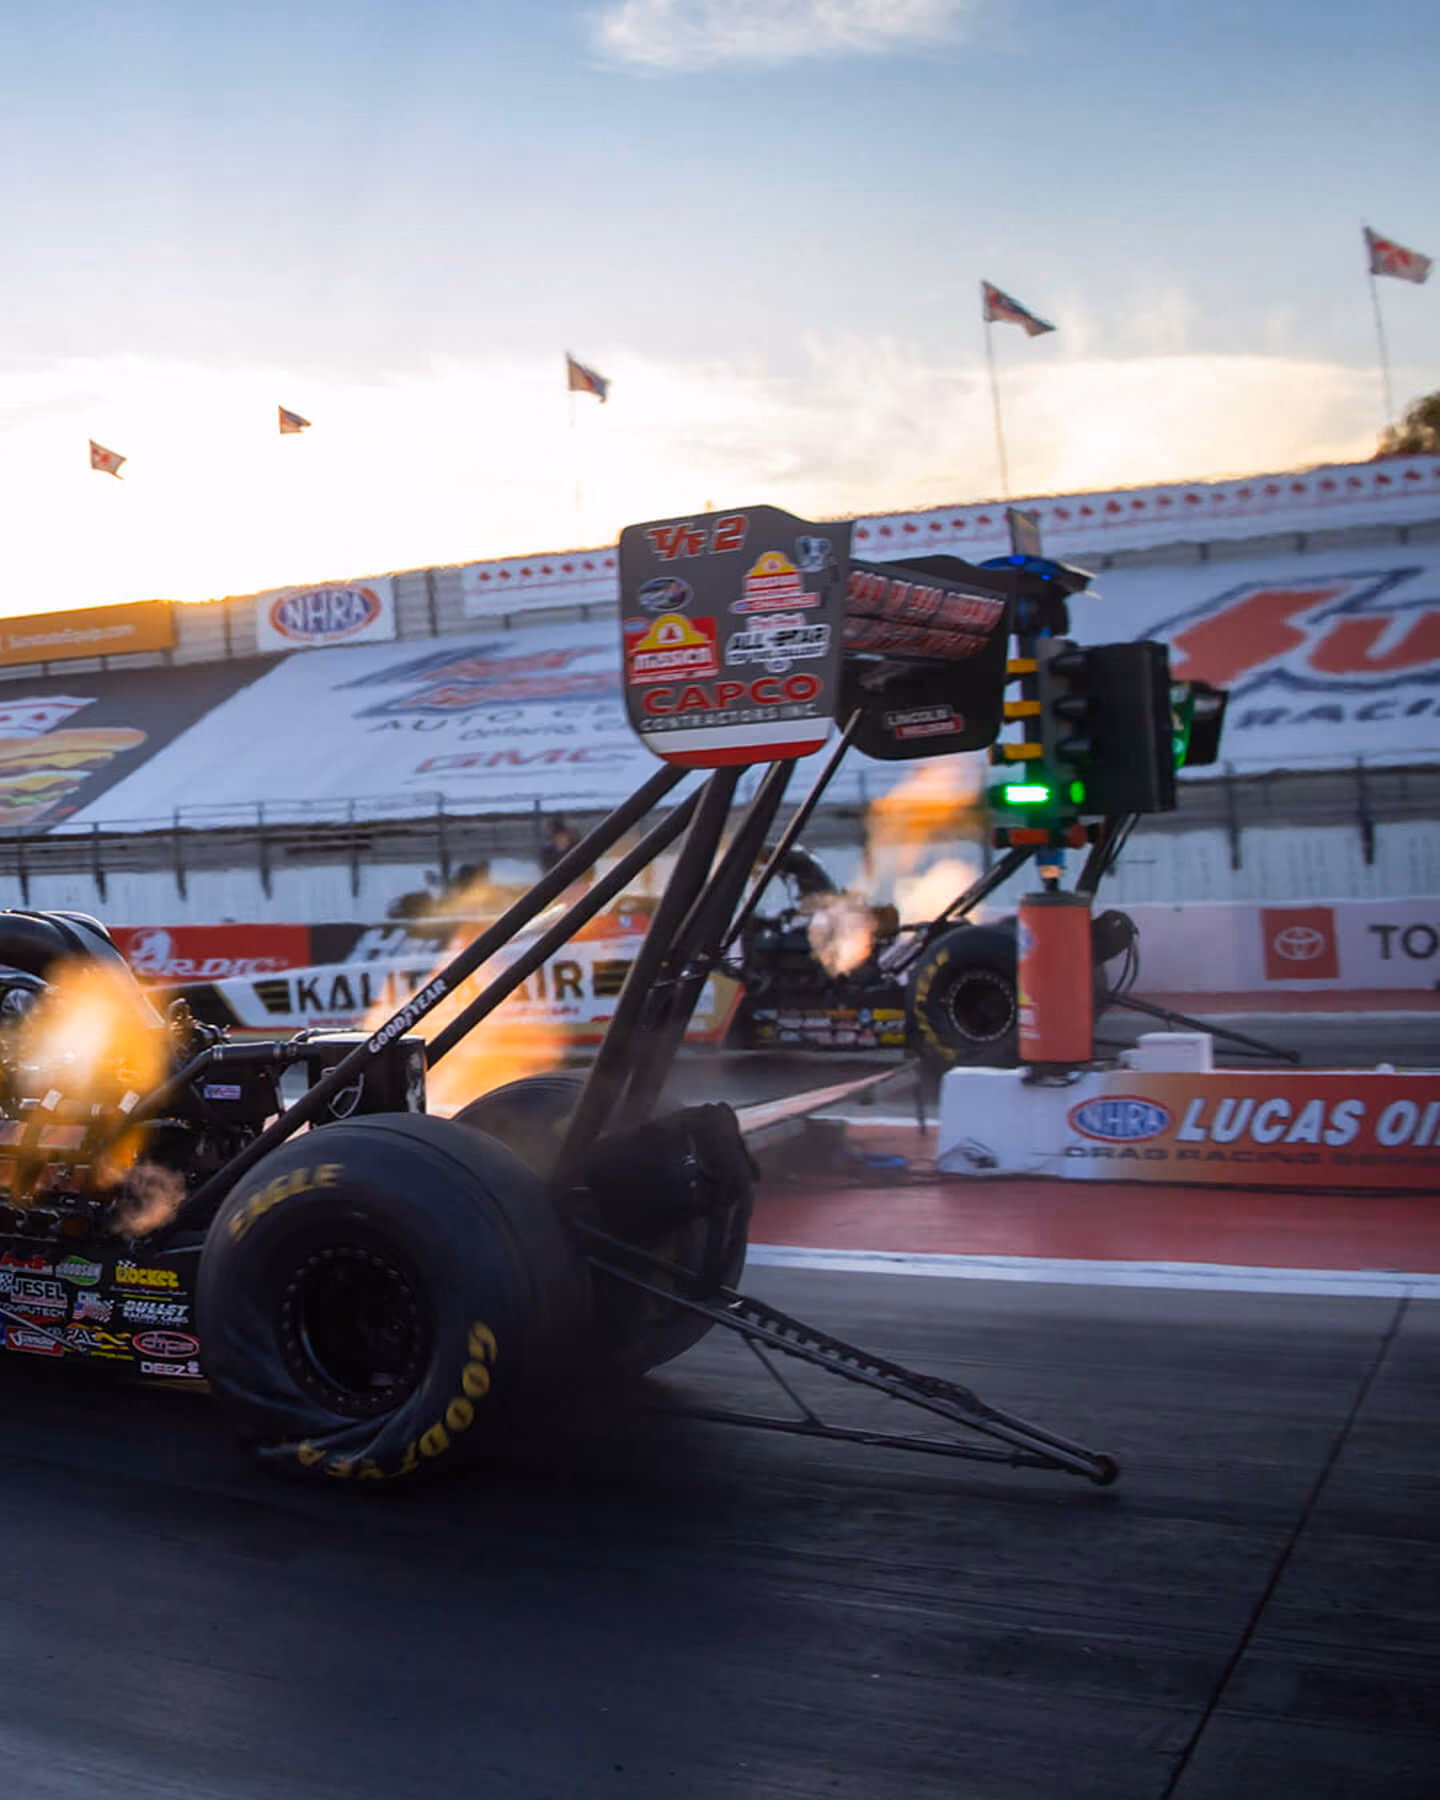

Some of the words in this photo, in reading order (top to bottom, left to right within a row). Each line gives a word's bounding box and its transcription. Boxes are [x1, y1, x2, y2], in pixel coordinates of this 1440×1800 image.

[709, 514, 747, 554] 2
[284, 588, 370, 634] NHRA
[642, 673, 823, 715] CAPCO
[640, 707, 778, 732] CONTRACTORS
[1367, 924, 1440, 960] TO
[296, 971, 486, 1015] KALITA
[368, 976, 449, 1055] GOODYEAR
[1081, 1099, 1169, 1138] NHRA
[1175, 1097, 1366, 1147] LUCAS
[1375, 1100, 1440, 1147] OI
[11, 1278, 67, 1301] JESEL
